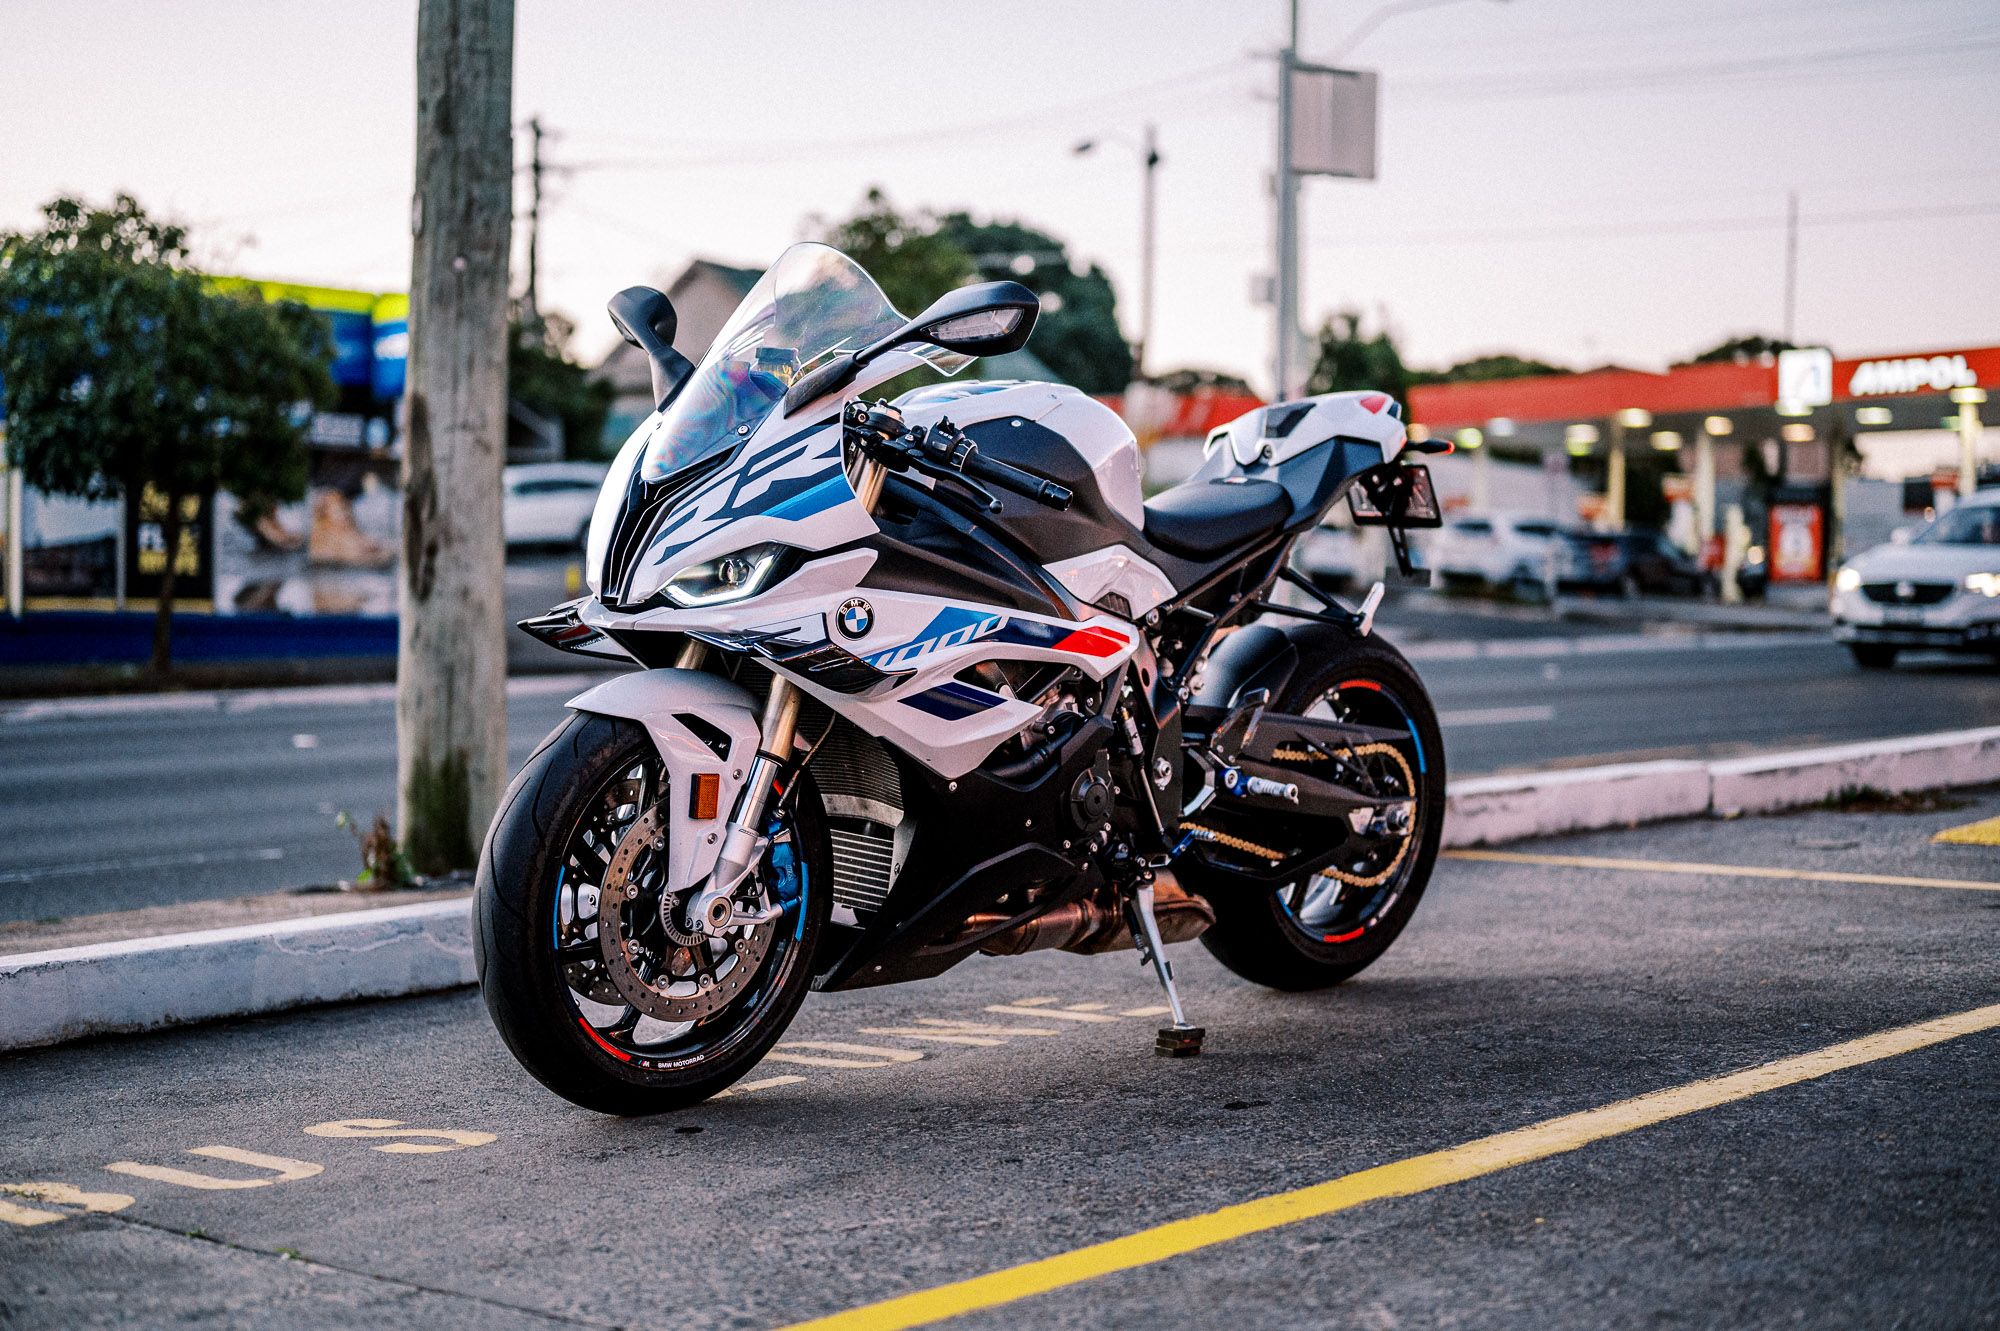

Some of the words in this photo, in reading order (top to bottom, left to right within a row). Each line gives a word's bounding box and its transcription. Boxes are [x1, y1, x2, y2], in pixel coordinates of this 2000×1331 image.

[1849, 356, 1977, 396] AMPOL
[840, 599, 871, 614] BMW
[657, 1061, 673, 1069] BMW
[673, 1054, 705, 1068] MOTORRAD
[0, 1118, 498, 1226] BUS
